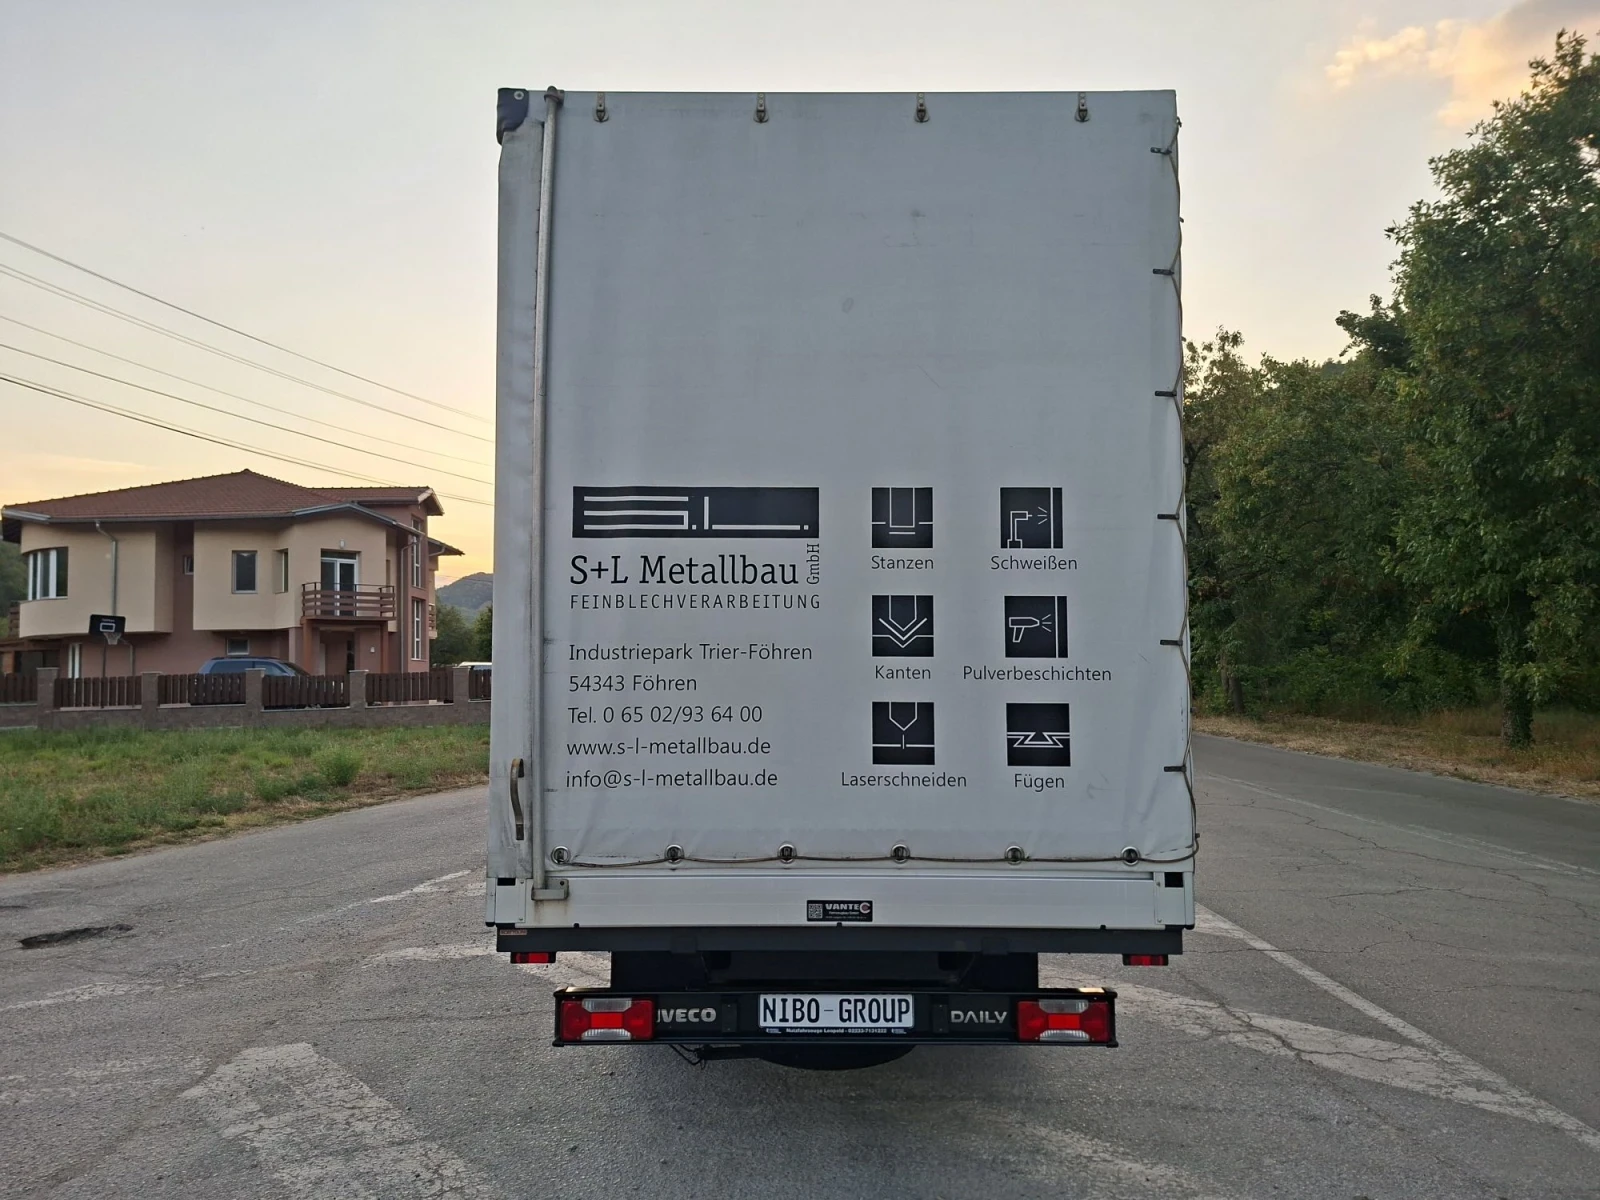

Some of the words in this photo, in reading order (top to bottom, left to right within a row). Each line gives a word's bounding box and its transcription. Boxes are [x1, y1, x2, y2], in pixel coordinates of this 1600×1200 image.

[570, 554, 629, 585] S+L
[638, 554, 799, 585] Metallbau
[805, 543, 820, 585] GmbH
[871, 555, 934, 570] Stanzen
[990, 555, 1078, 570] Schweißen
[570, 593, 820, 610] FEINBLECHVERARBEITUNG
[569, 642, 693, 665] Industriepark
[698, 642, 812, 660] Trier-Föhren
[875, 664, 931, 680] Kanten
[963, 665, 1112, 681] Pulverbeschichten
[569, 674, 625, 693] 54343
[633, 673, 697, 692] Föhren
[567, 706, 597, 724] Tel.
[603, 706, 615, 724] 0
[621, 706, 643, 723] 65
[650, 705, 704, 725] 02/93
[711, 705, 734, 723] 64
[740, 705, 763, 723] 00
[566, 736, 771, 756] www.s-l-metallbau.de
[566, 768, 778, 789] info@s-l-metallbau.de
[841, 771, 967, 788] Laserschneiden
[1014, 773, 1065, 793] Fügen
[826, 902, 870, 914] VANTEC
[951, 1011, 1007, 1023] DAILY
